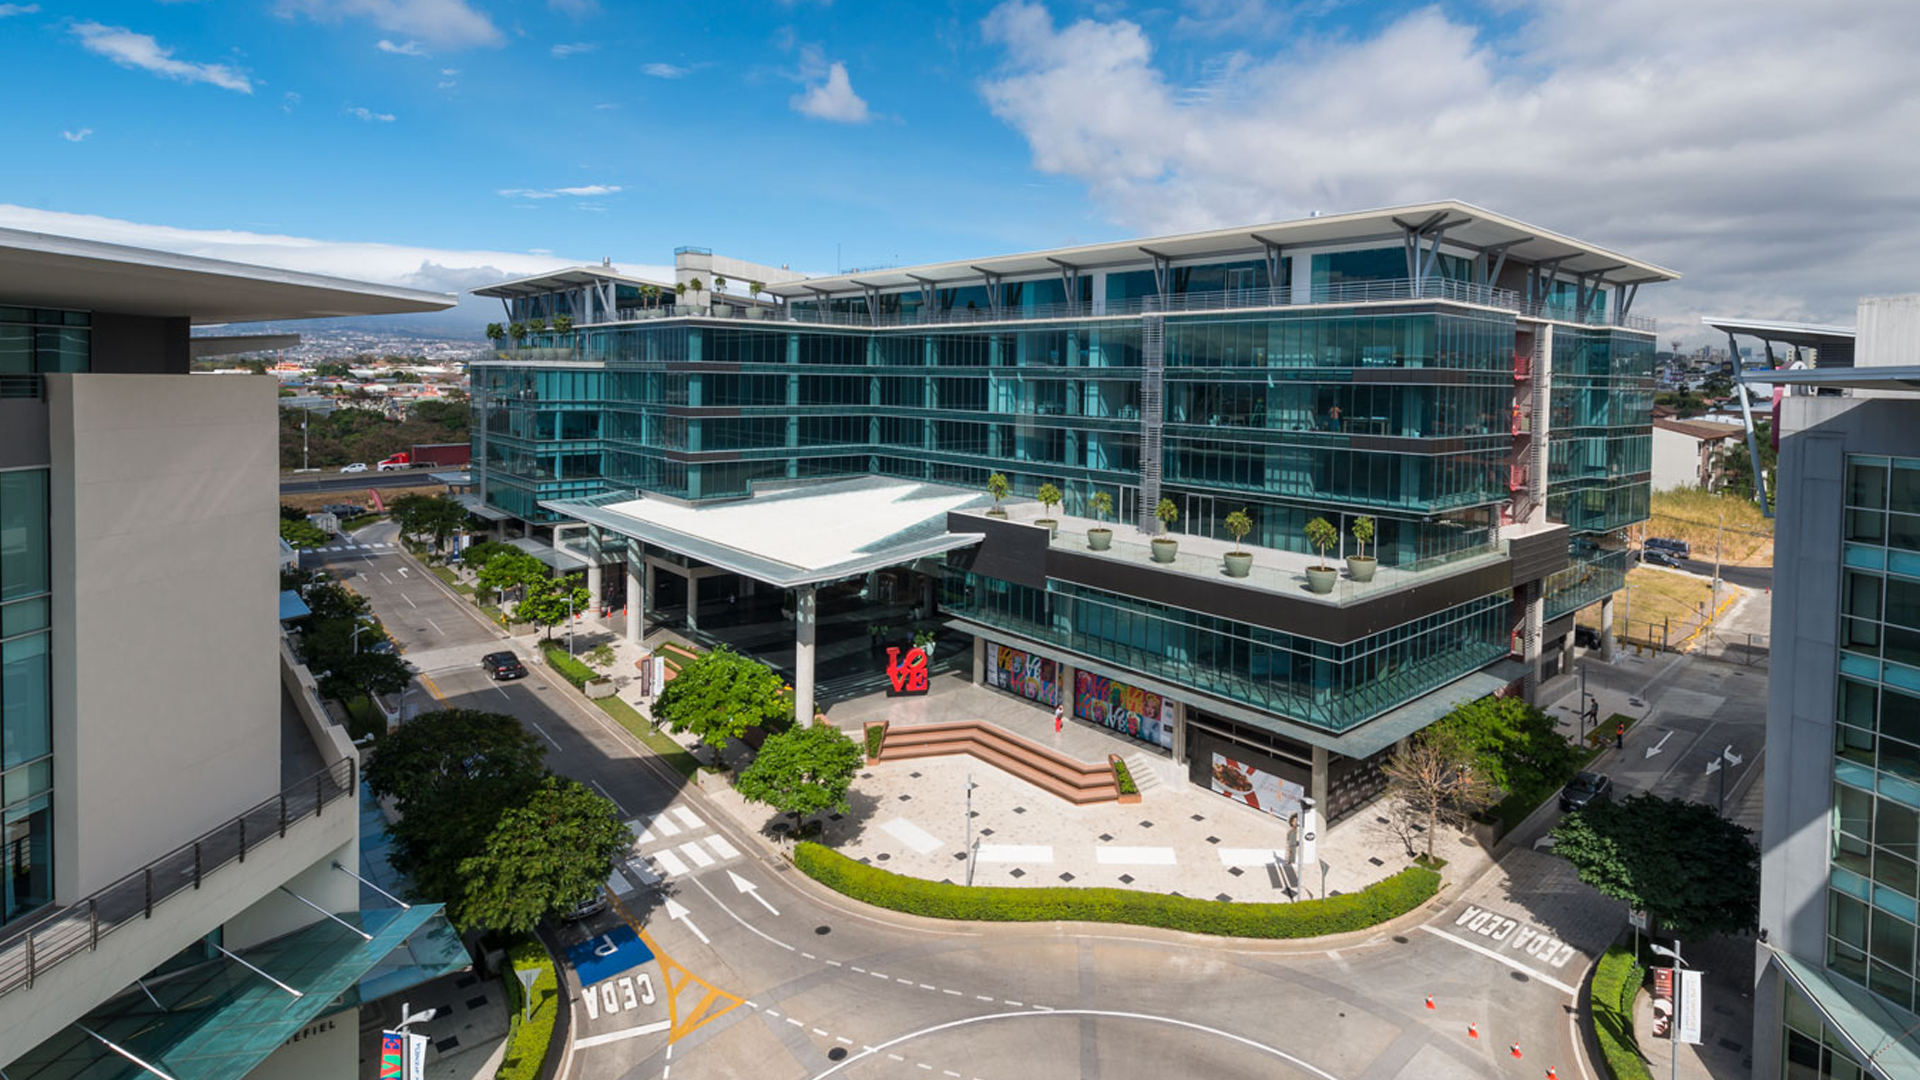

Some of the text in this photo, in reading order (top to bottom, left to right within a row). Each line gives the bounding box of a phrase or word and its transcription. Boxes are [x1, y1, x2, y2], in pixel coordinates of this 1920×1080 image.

[1454, 905, 1519, 941] CEDA
[1512, 926, 1577, 968] CEDA
[581, 972, 656, 1020] CEDA
